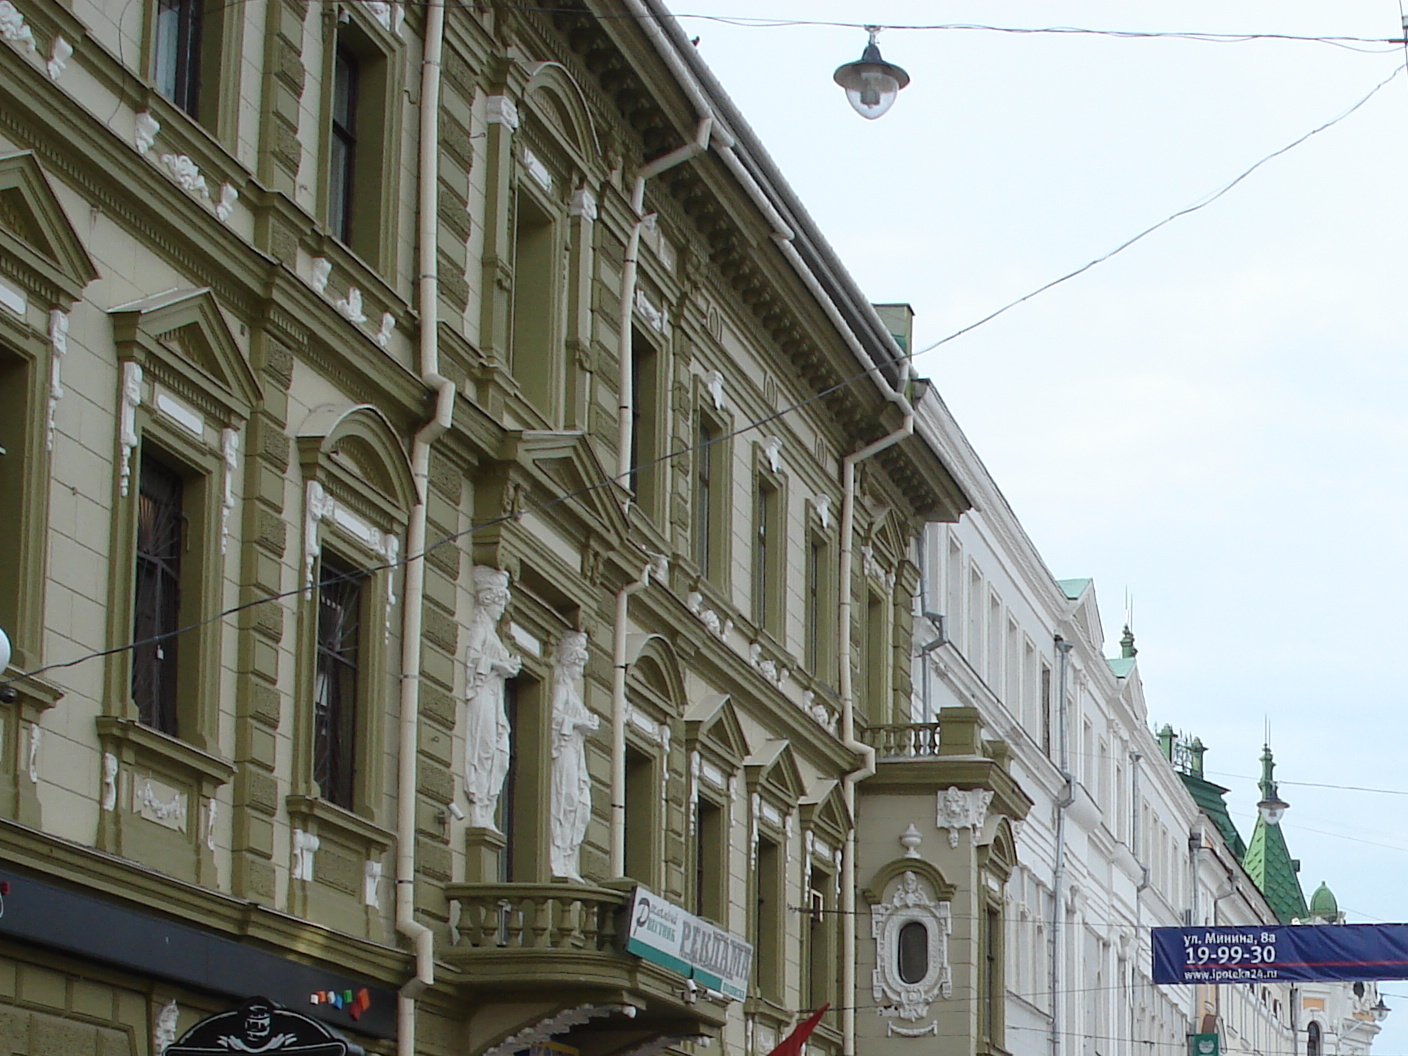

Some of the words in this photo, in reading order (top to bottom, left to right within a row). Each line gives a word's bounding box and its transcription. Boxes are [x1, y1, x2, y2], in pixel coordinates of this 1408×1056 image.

[1183, 934, 1202, 946] ул.
[1205, 932, 1257, 946] Минина,
[1261, 932, 1276, 943] 8а
[680, 920, 750, 981] РЕКЛАМА
[1185, 946, 1276, 966] 19-99-30
[1184, 968, 1278, 981] www.ipoteka24.ru
